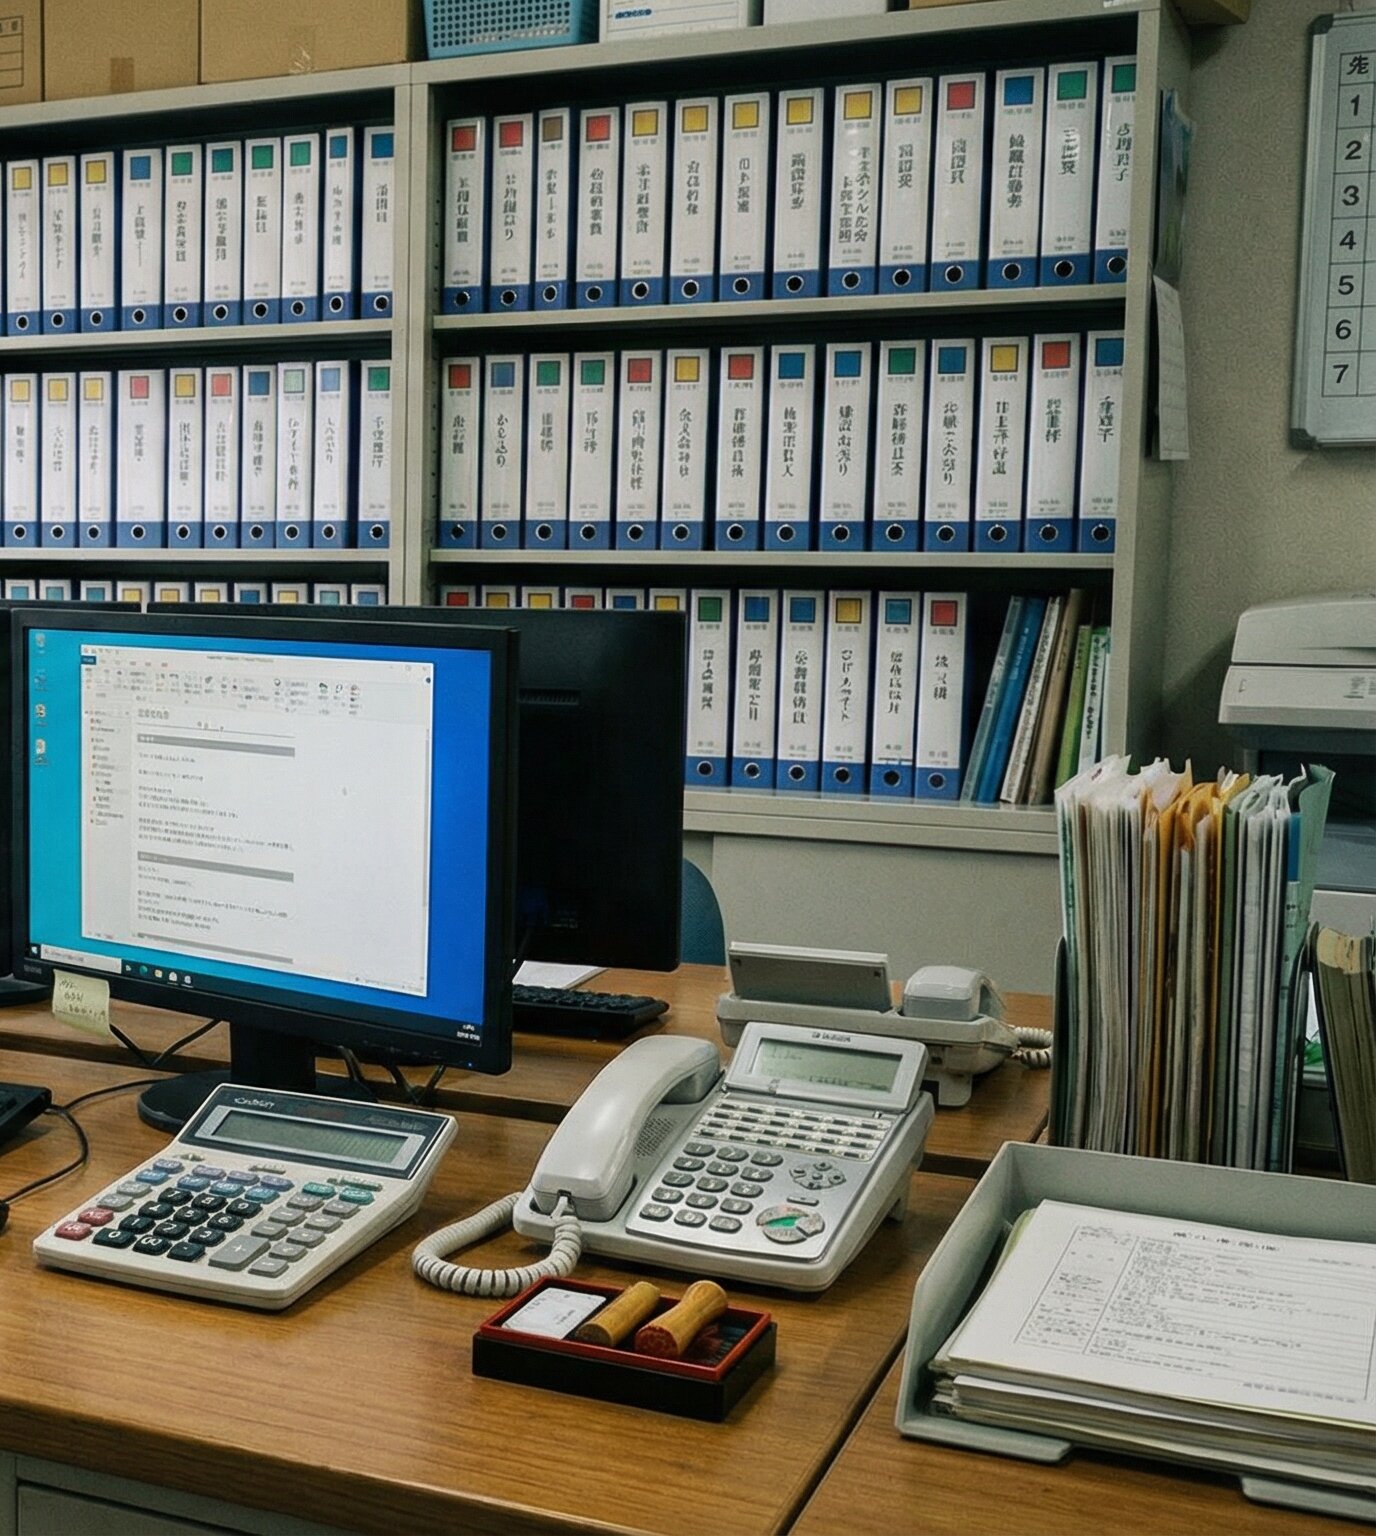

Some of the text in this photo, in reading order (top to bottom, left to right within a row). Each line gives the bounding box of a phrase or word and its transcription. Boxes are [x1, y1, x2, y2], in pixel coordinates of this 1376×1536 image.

[1350, 94, 1360, 117] 1
[1344, 140, 1362, 161] 2
[1341, 184, 1360, 207] 3
[1339, 230, 1357, 251] 4
[1337, 274, 1355, 296] 5
[1335, 319, 1352, 340] 6
[1332, 363, 1349, 384] 7
[108, 1231, 122, 1239] 0
